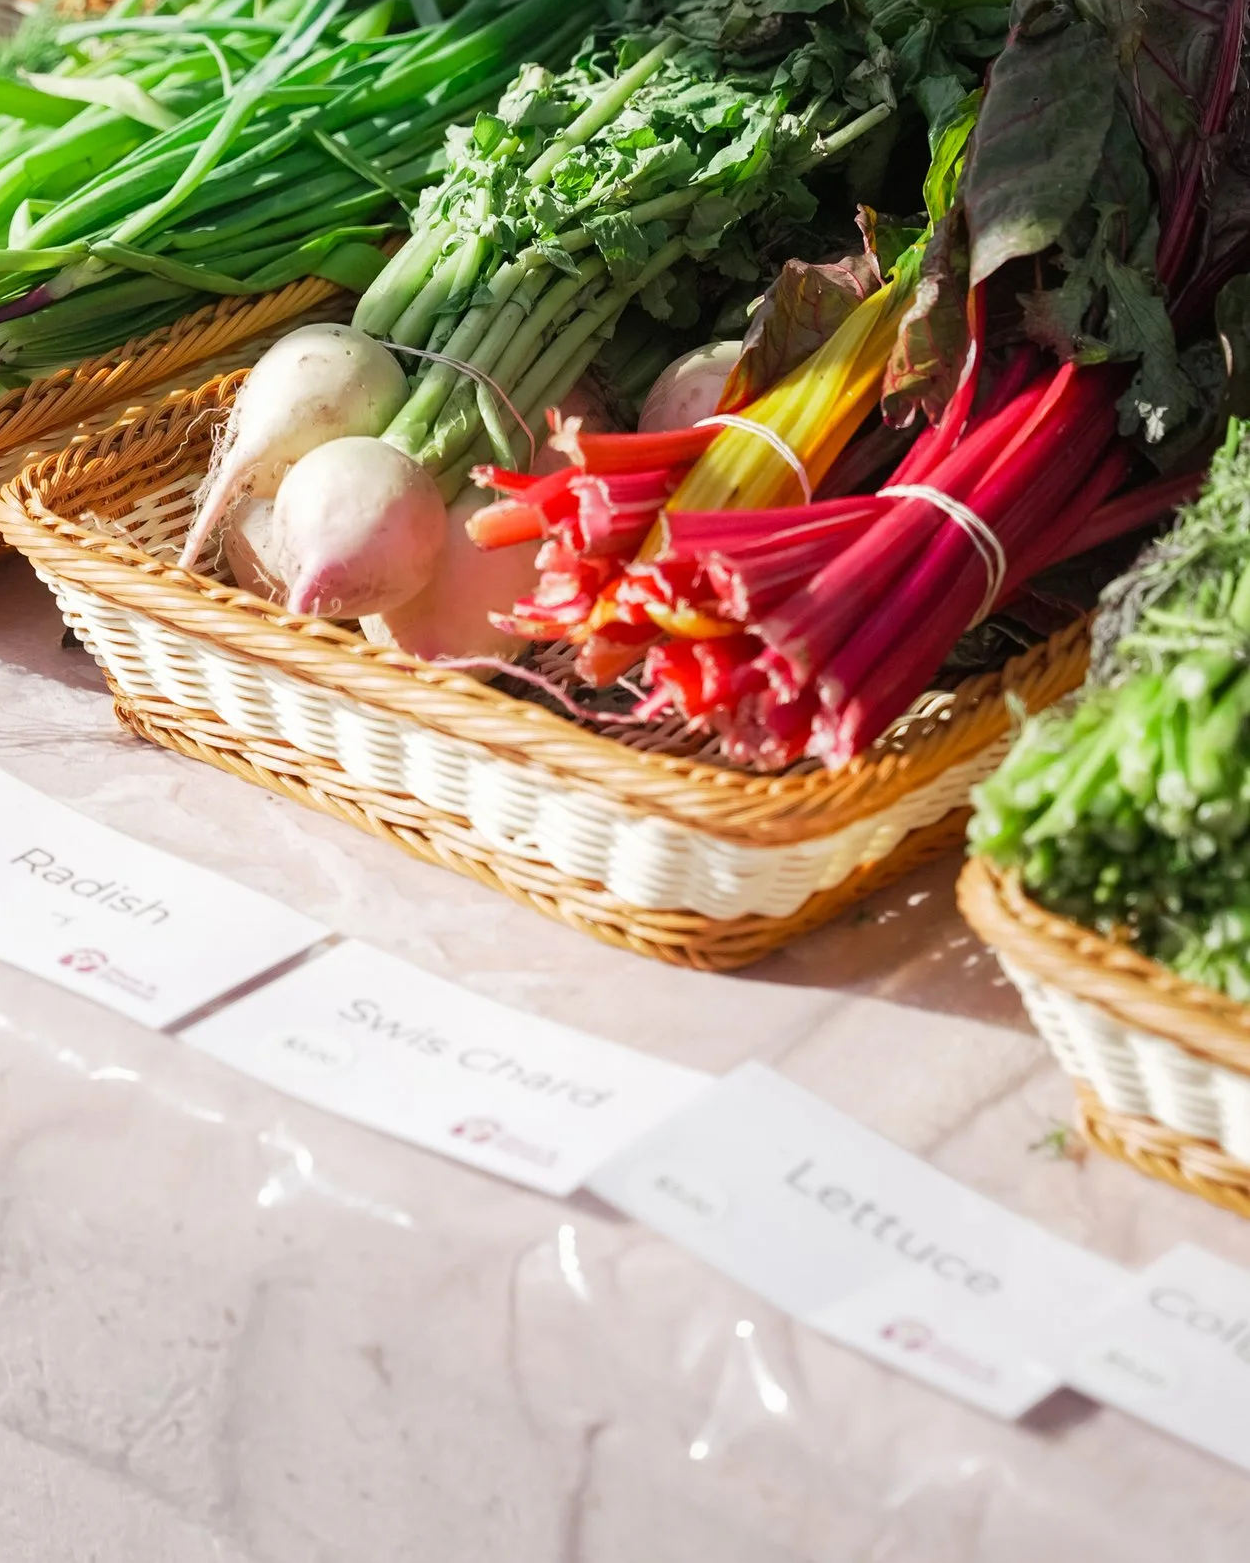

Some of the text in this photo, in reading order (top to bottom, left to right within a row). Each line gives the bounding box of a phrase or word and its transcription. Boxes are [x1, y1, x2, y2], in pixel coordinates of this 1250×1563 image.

[9, 847, 171, 927] Radish
[338, 999, 447, 1057] Swis
[458, 1047, 611, 1109] Chard
[783, 1159, 1003, 1296] Lettuce
